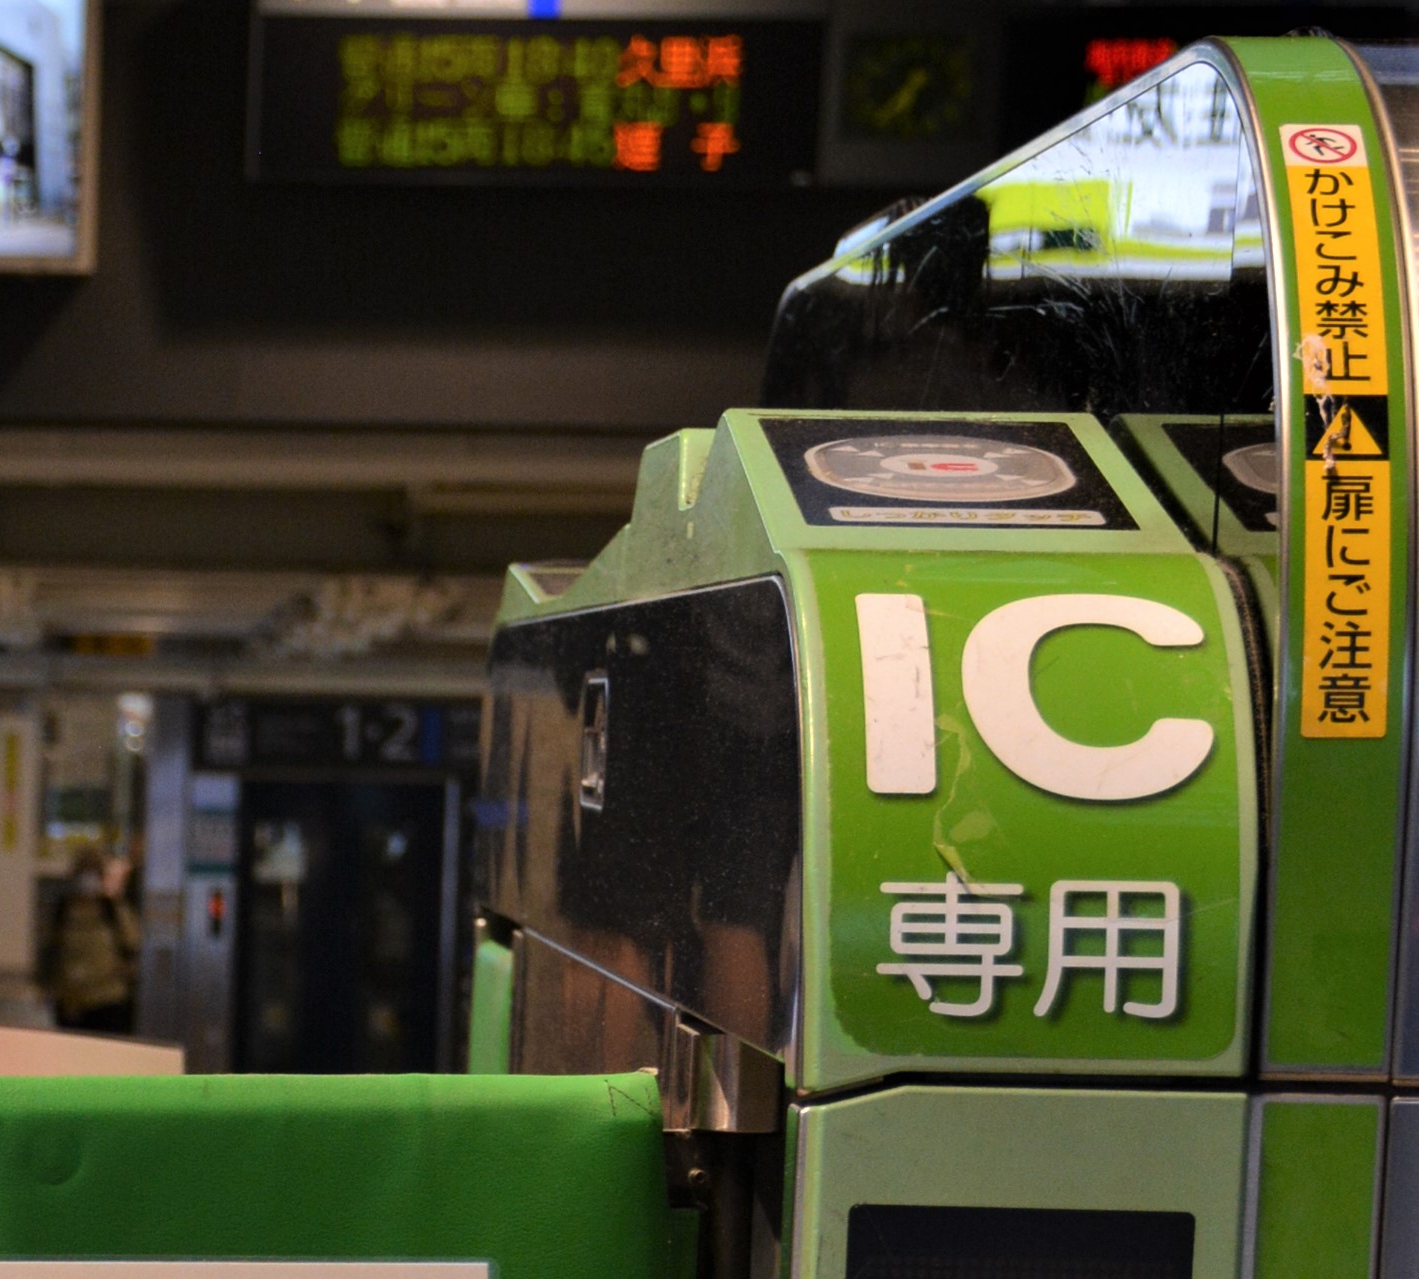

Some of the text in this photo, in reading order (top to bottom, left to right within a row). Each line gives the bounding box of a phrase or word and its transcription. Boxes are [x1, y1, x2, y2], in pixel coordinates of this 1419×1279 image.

[1305, 168, 1372, 384] かけこみ禁止
[855, 593, 1215, 801] IC
[1317, 473, 1374, 724] 扉にご注意
[876, 870, 1180, 1019] 専用
